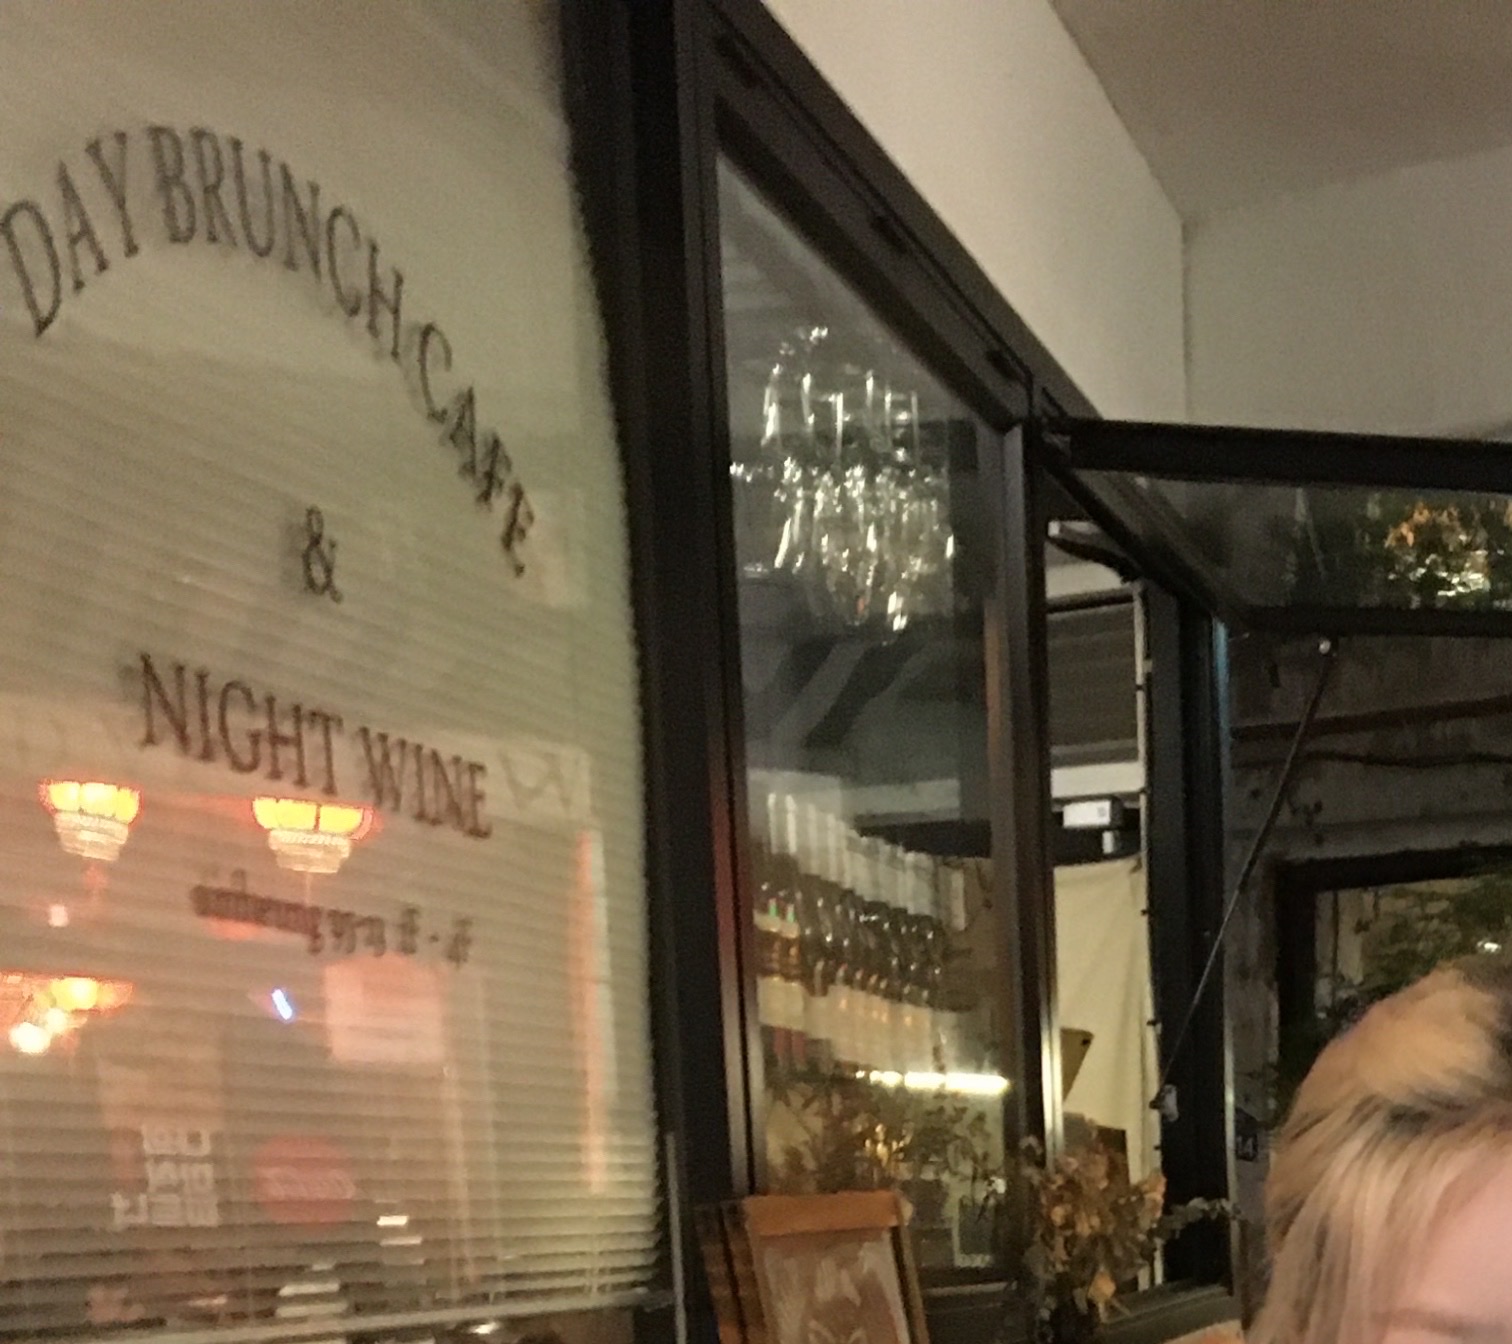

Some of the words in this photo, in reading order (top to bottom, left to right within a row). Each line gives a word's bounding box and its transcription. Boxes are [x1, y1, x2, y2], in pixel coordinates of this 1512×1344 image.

[0, 130, 140, 338] DAY
[146, 124, 404, 360] BRUNCH
[302, 506, 343, 604] &
[136, 652, 346, 796] NIGHT
[356, 725, 494, 840] WINE
